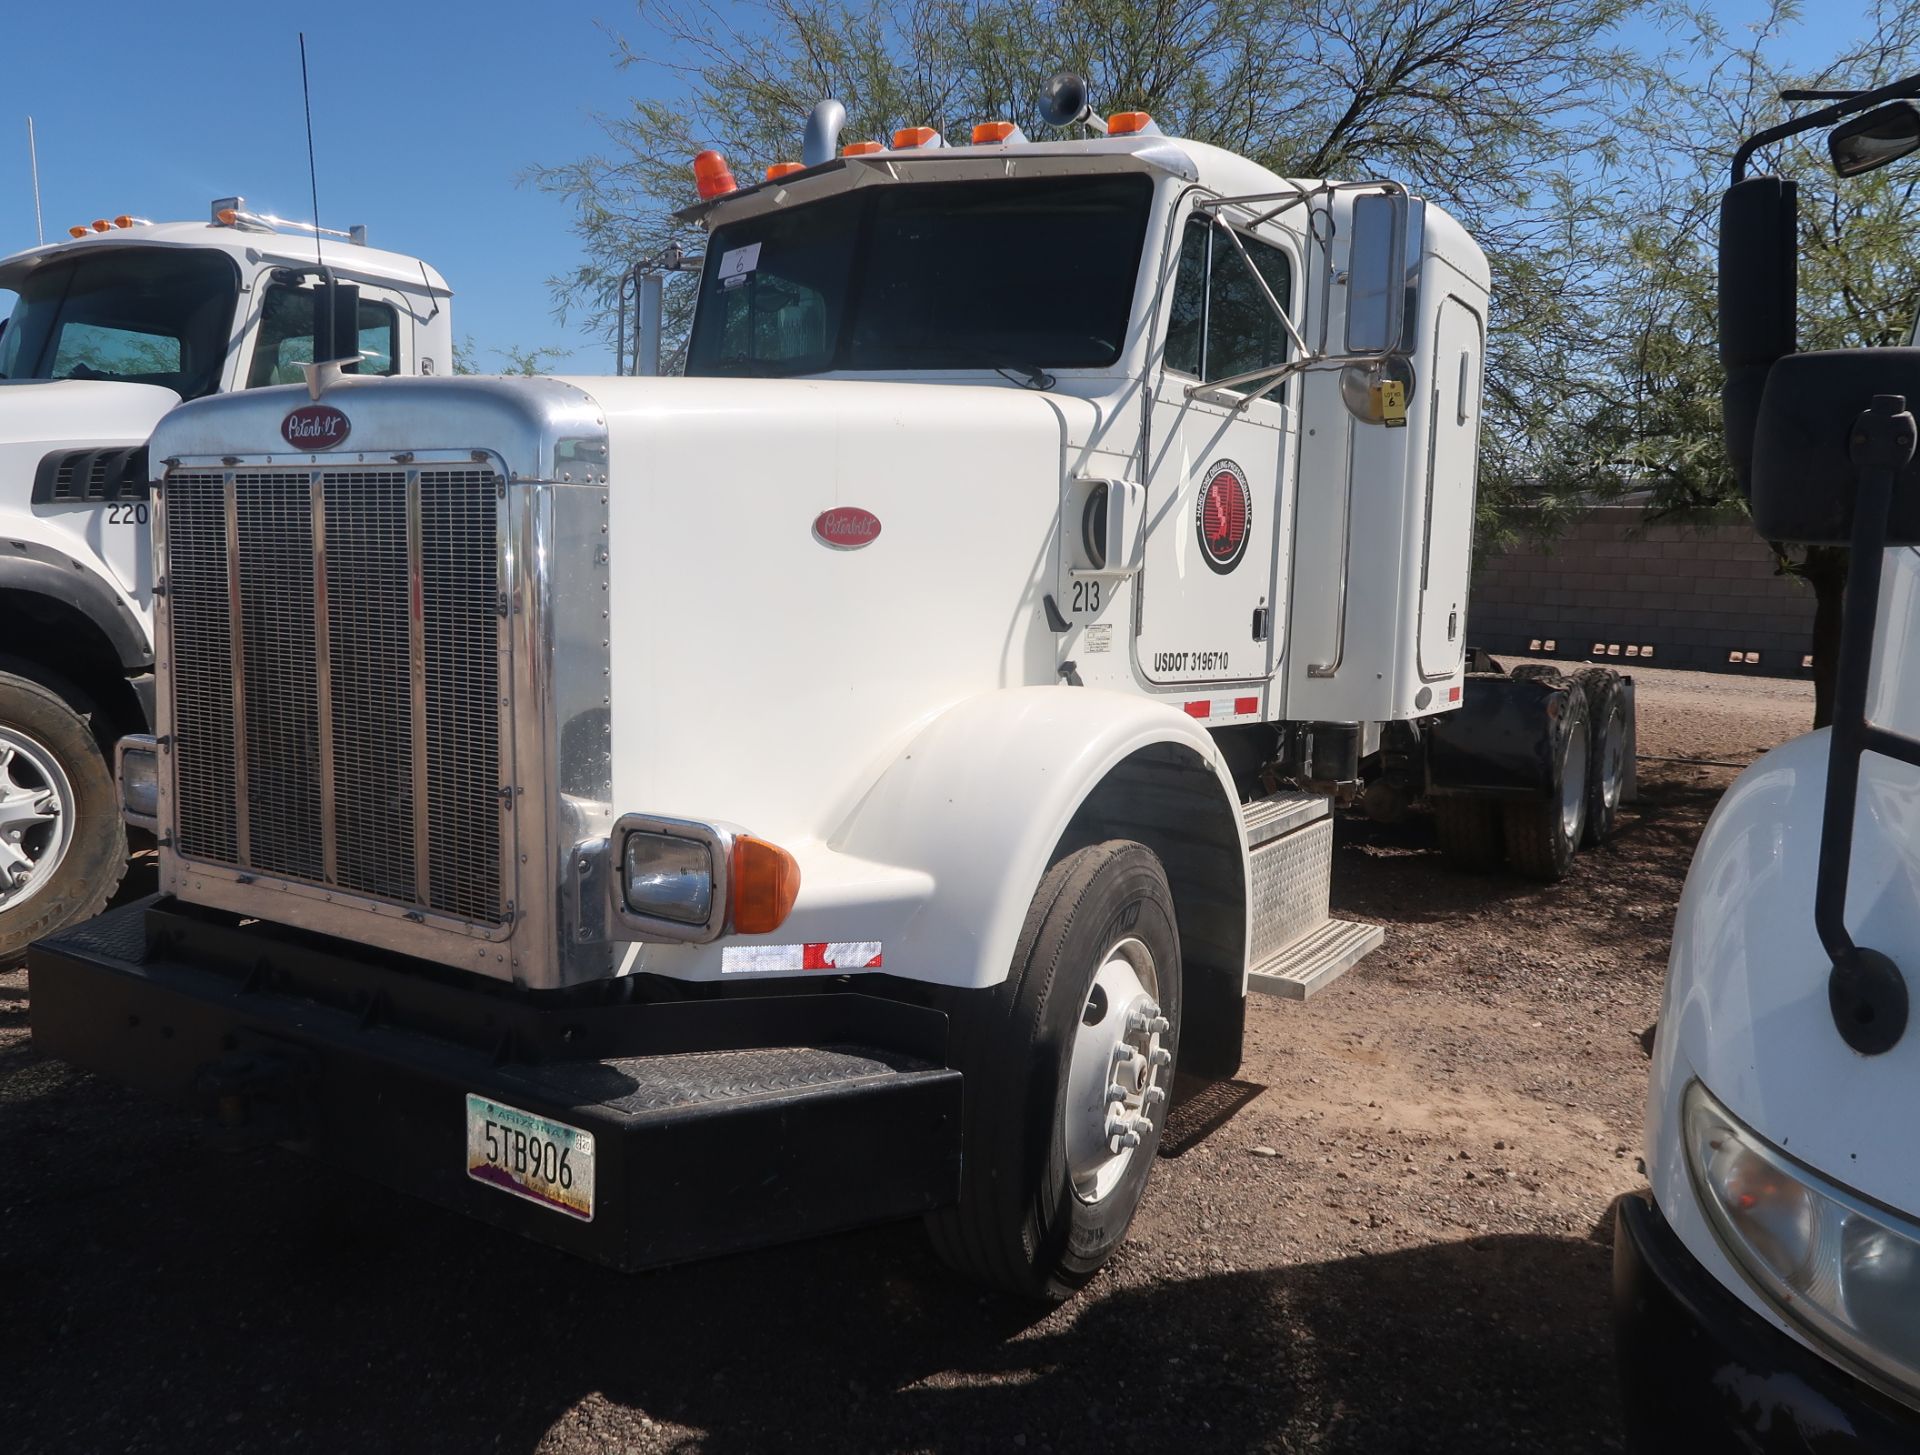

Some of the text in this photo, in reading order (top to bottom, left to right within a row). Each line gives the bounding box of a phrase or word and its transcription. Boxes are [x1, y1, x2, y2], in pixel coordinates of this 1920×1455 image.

[735, 255, 744, 273] 6
[1388, 397, 1396, 407] 6
[288, 415, 341, 440] Peterbilt
[108, 503, 148, 525] 220
[1196, 493, 1205, 517] HARD
[824, 512, 877, 537] Peterbilt
[1072, 580, 1100, 612] 213
[1154, 651, 1229, 672] USDOT 3196710
[497, 1111, 561, 1137] ARIZONA
[486, 1119, 573, 1190] 5TB906
